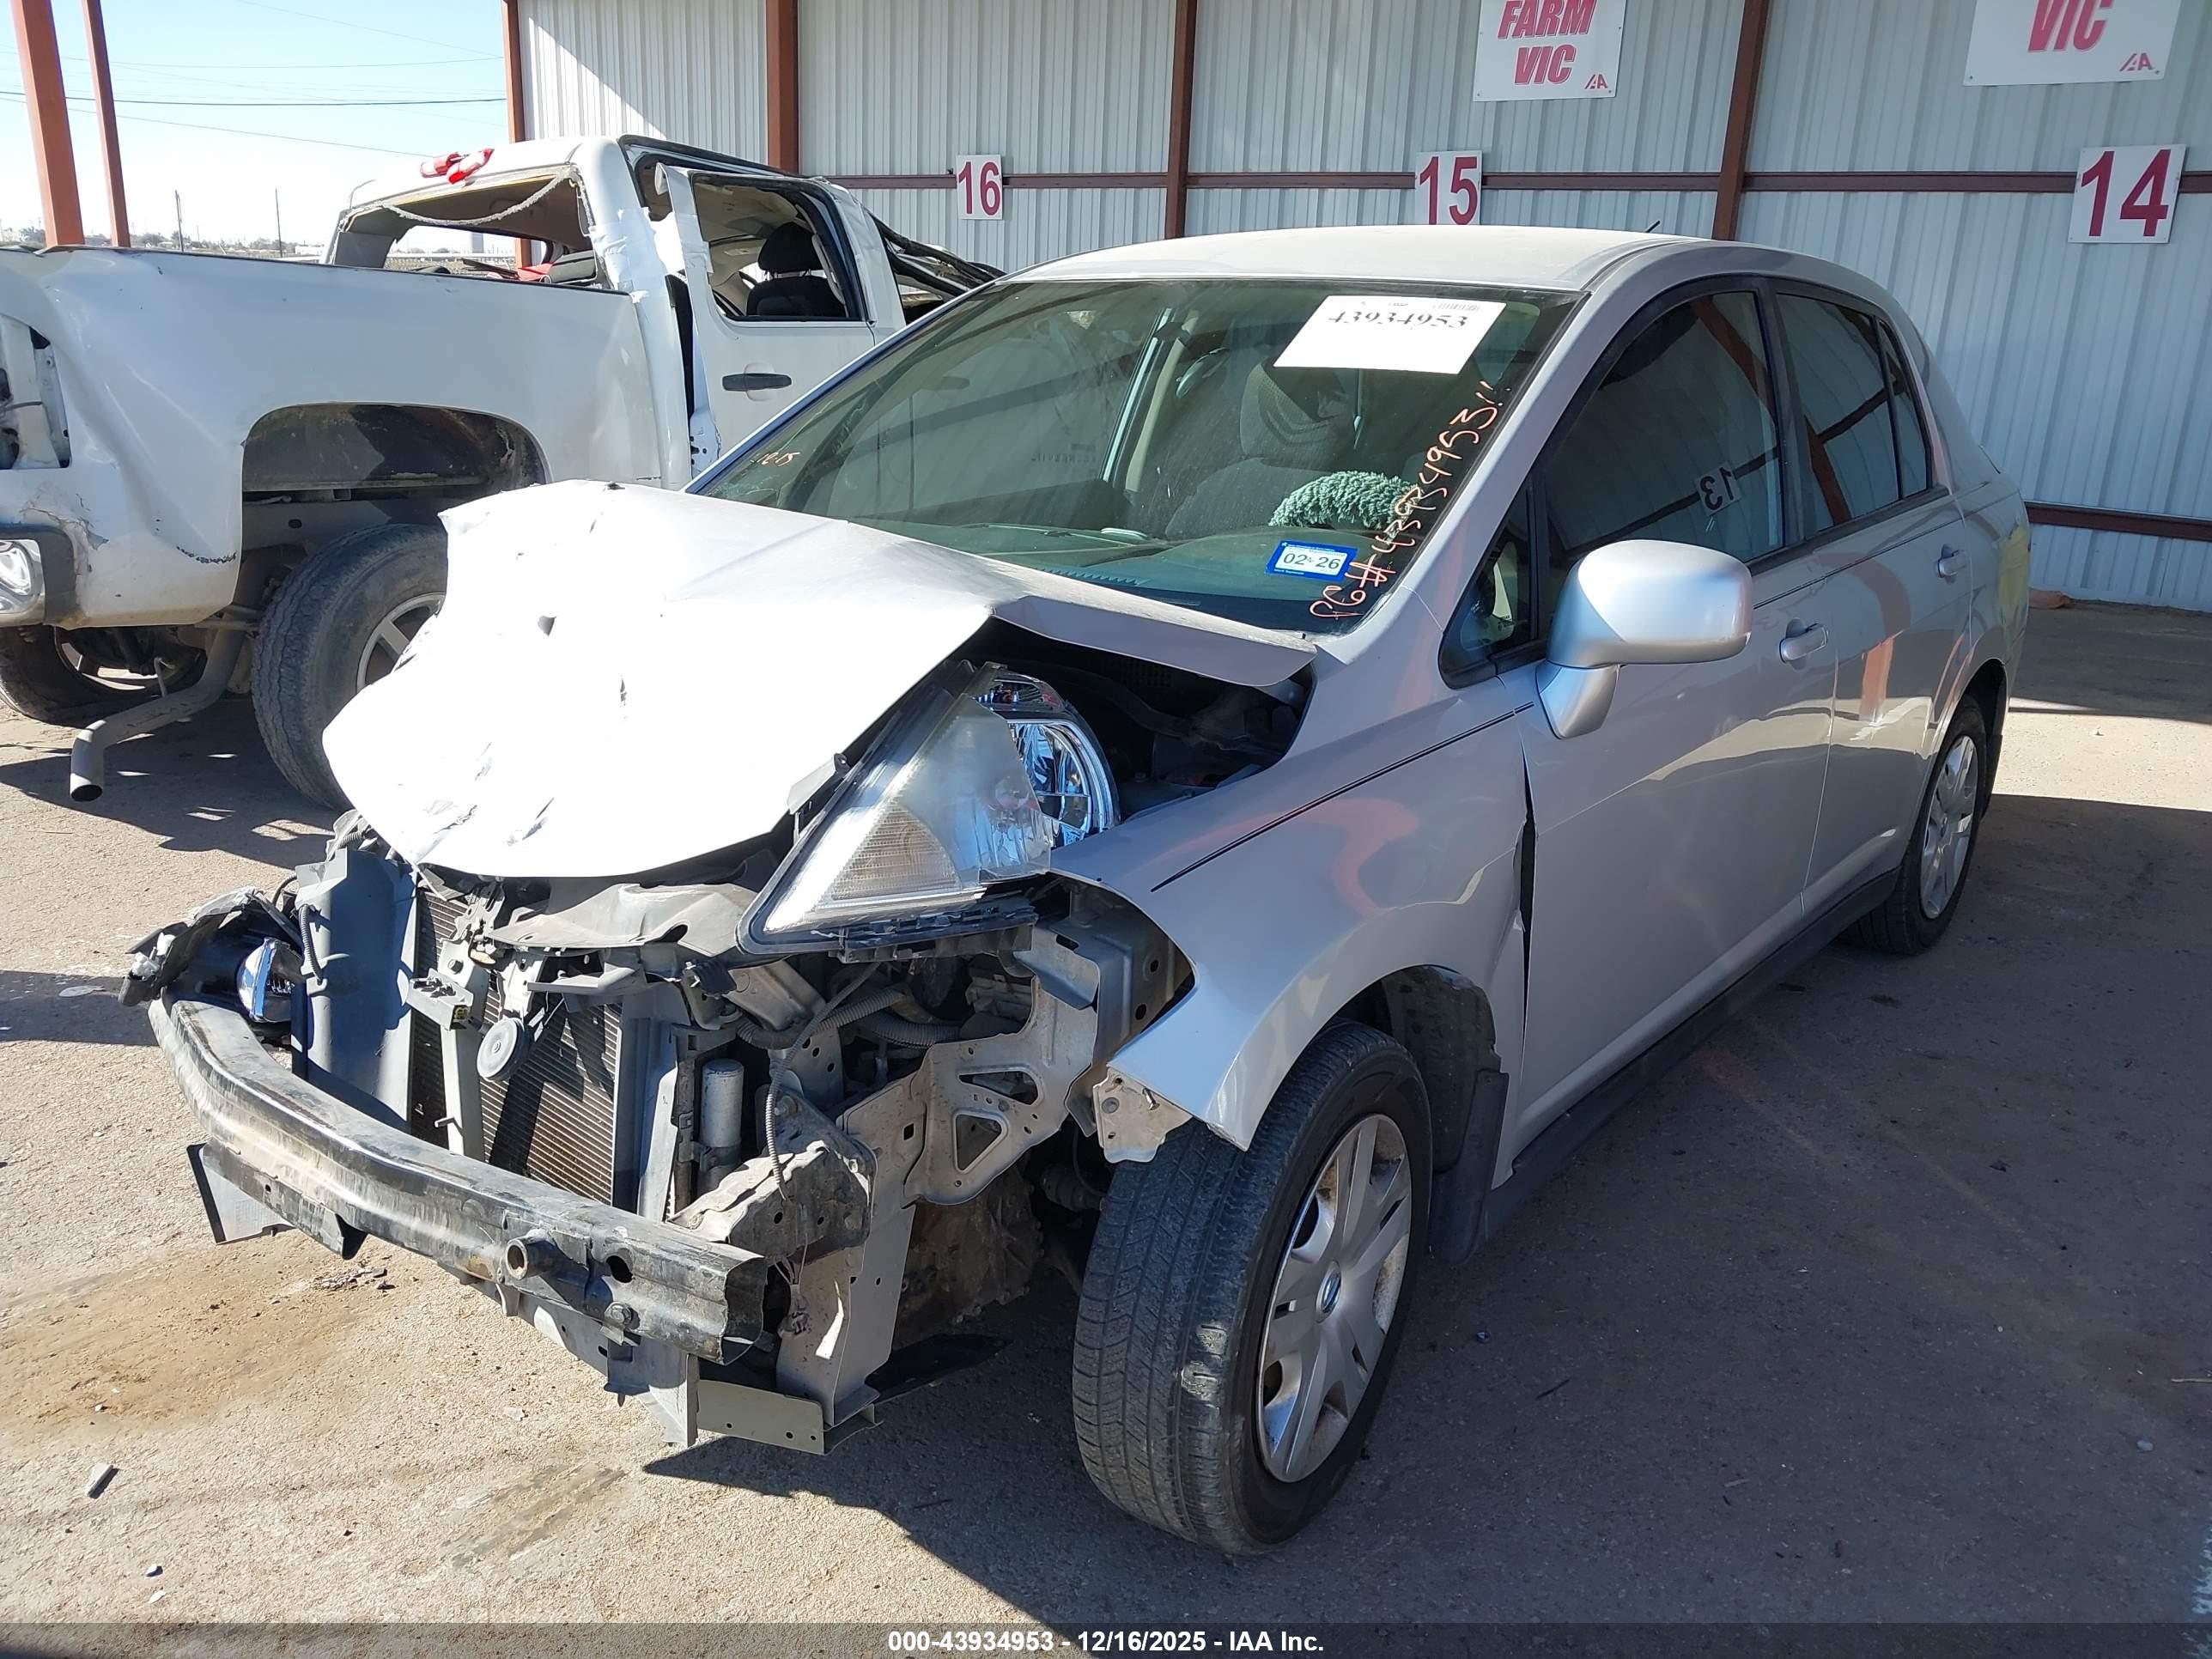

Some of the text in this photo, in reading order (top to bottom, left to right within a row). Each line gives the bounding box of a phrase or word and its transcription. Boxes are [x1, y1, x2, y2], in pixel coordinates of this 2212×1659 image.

[1498, 0, 1597, 40] FARM
[2027, 0, 2114, 52] VIC
[1514, 45, 1576, 85] VIC
[958, 161, 1000, 216] 16
[1419, 156, 1478, 225] 15
[2081, 149, 2172, 237] 14
[1284, 553, 1308, 566] 02
[1316, 556, 1341, 569] 26
